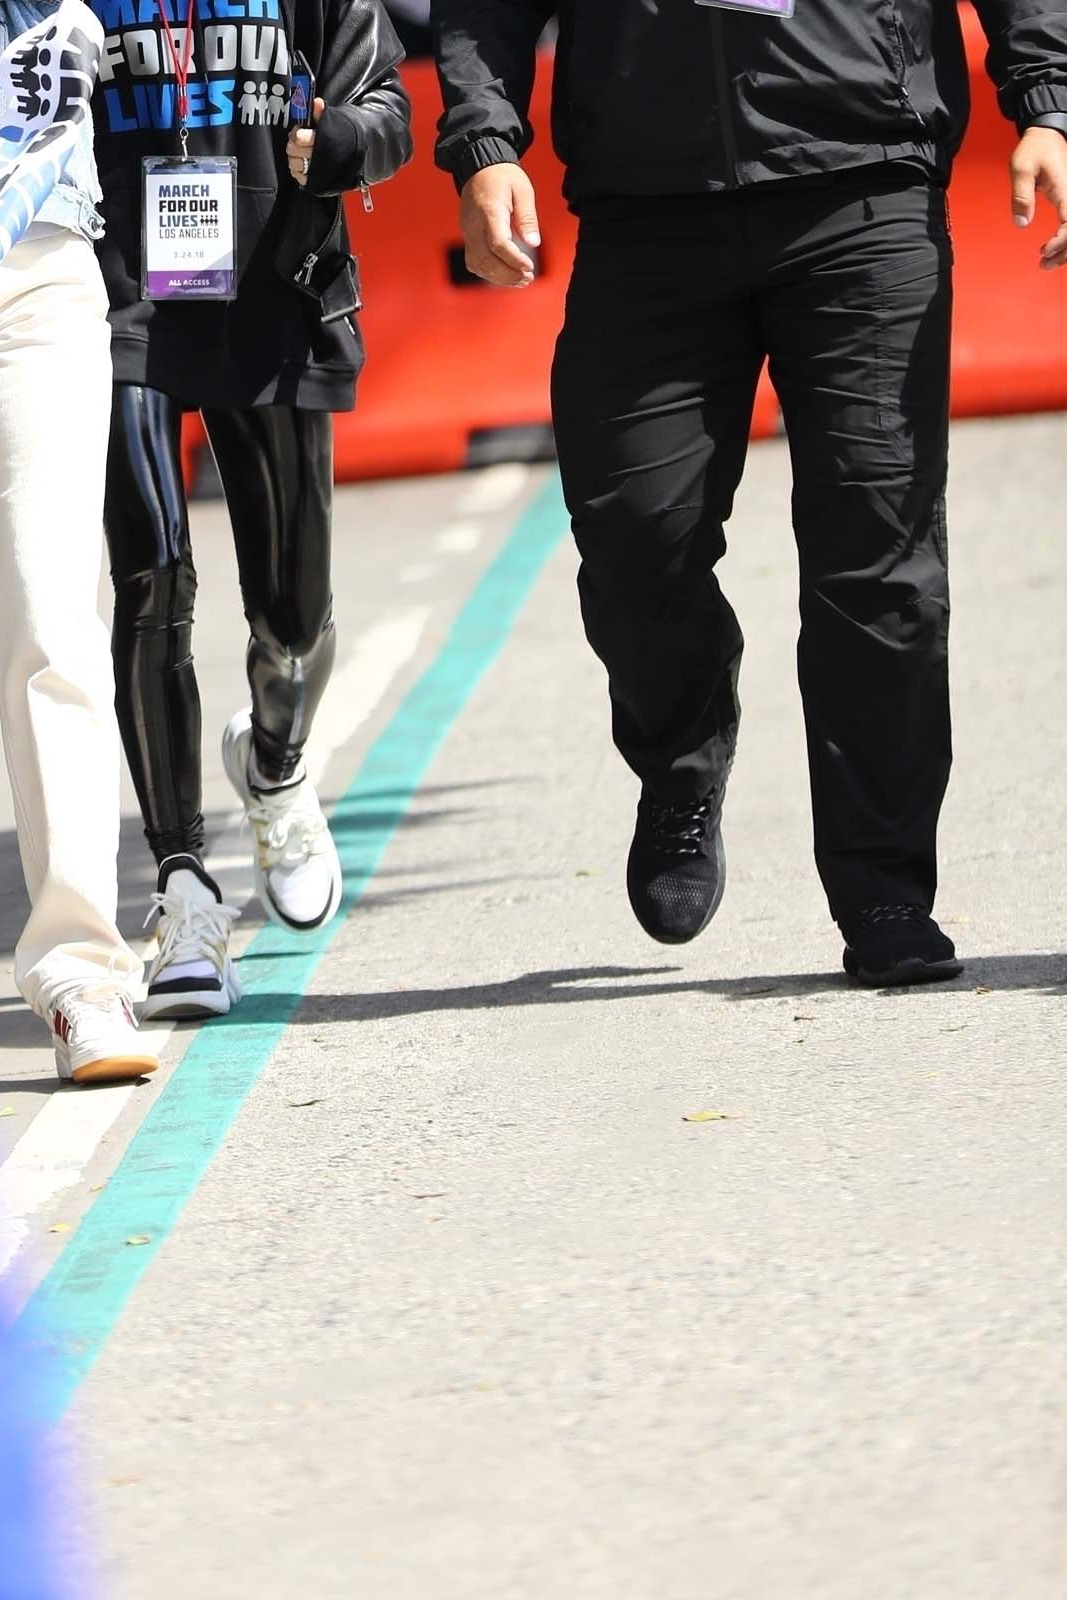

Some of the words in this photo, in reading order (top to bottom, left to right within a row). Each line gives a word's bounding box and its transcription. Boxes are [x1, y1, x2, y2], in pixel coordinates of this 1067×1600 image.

[98, 27, 197, 82] FOR
[103, 79, 236, 133] LIVES
[158, 185, 210, 198] MARCH
[158, 200, 187, 212] FOR
[189, 199, 218, 212] OUR
[159, 215, 198, 227] LIVES
[159, 228, 176, 239] LOS
[179, 228, 219, 239] ANGELES
[168, 279, 182, 287] ALL
